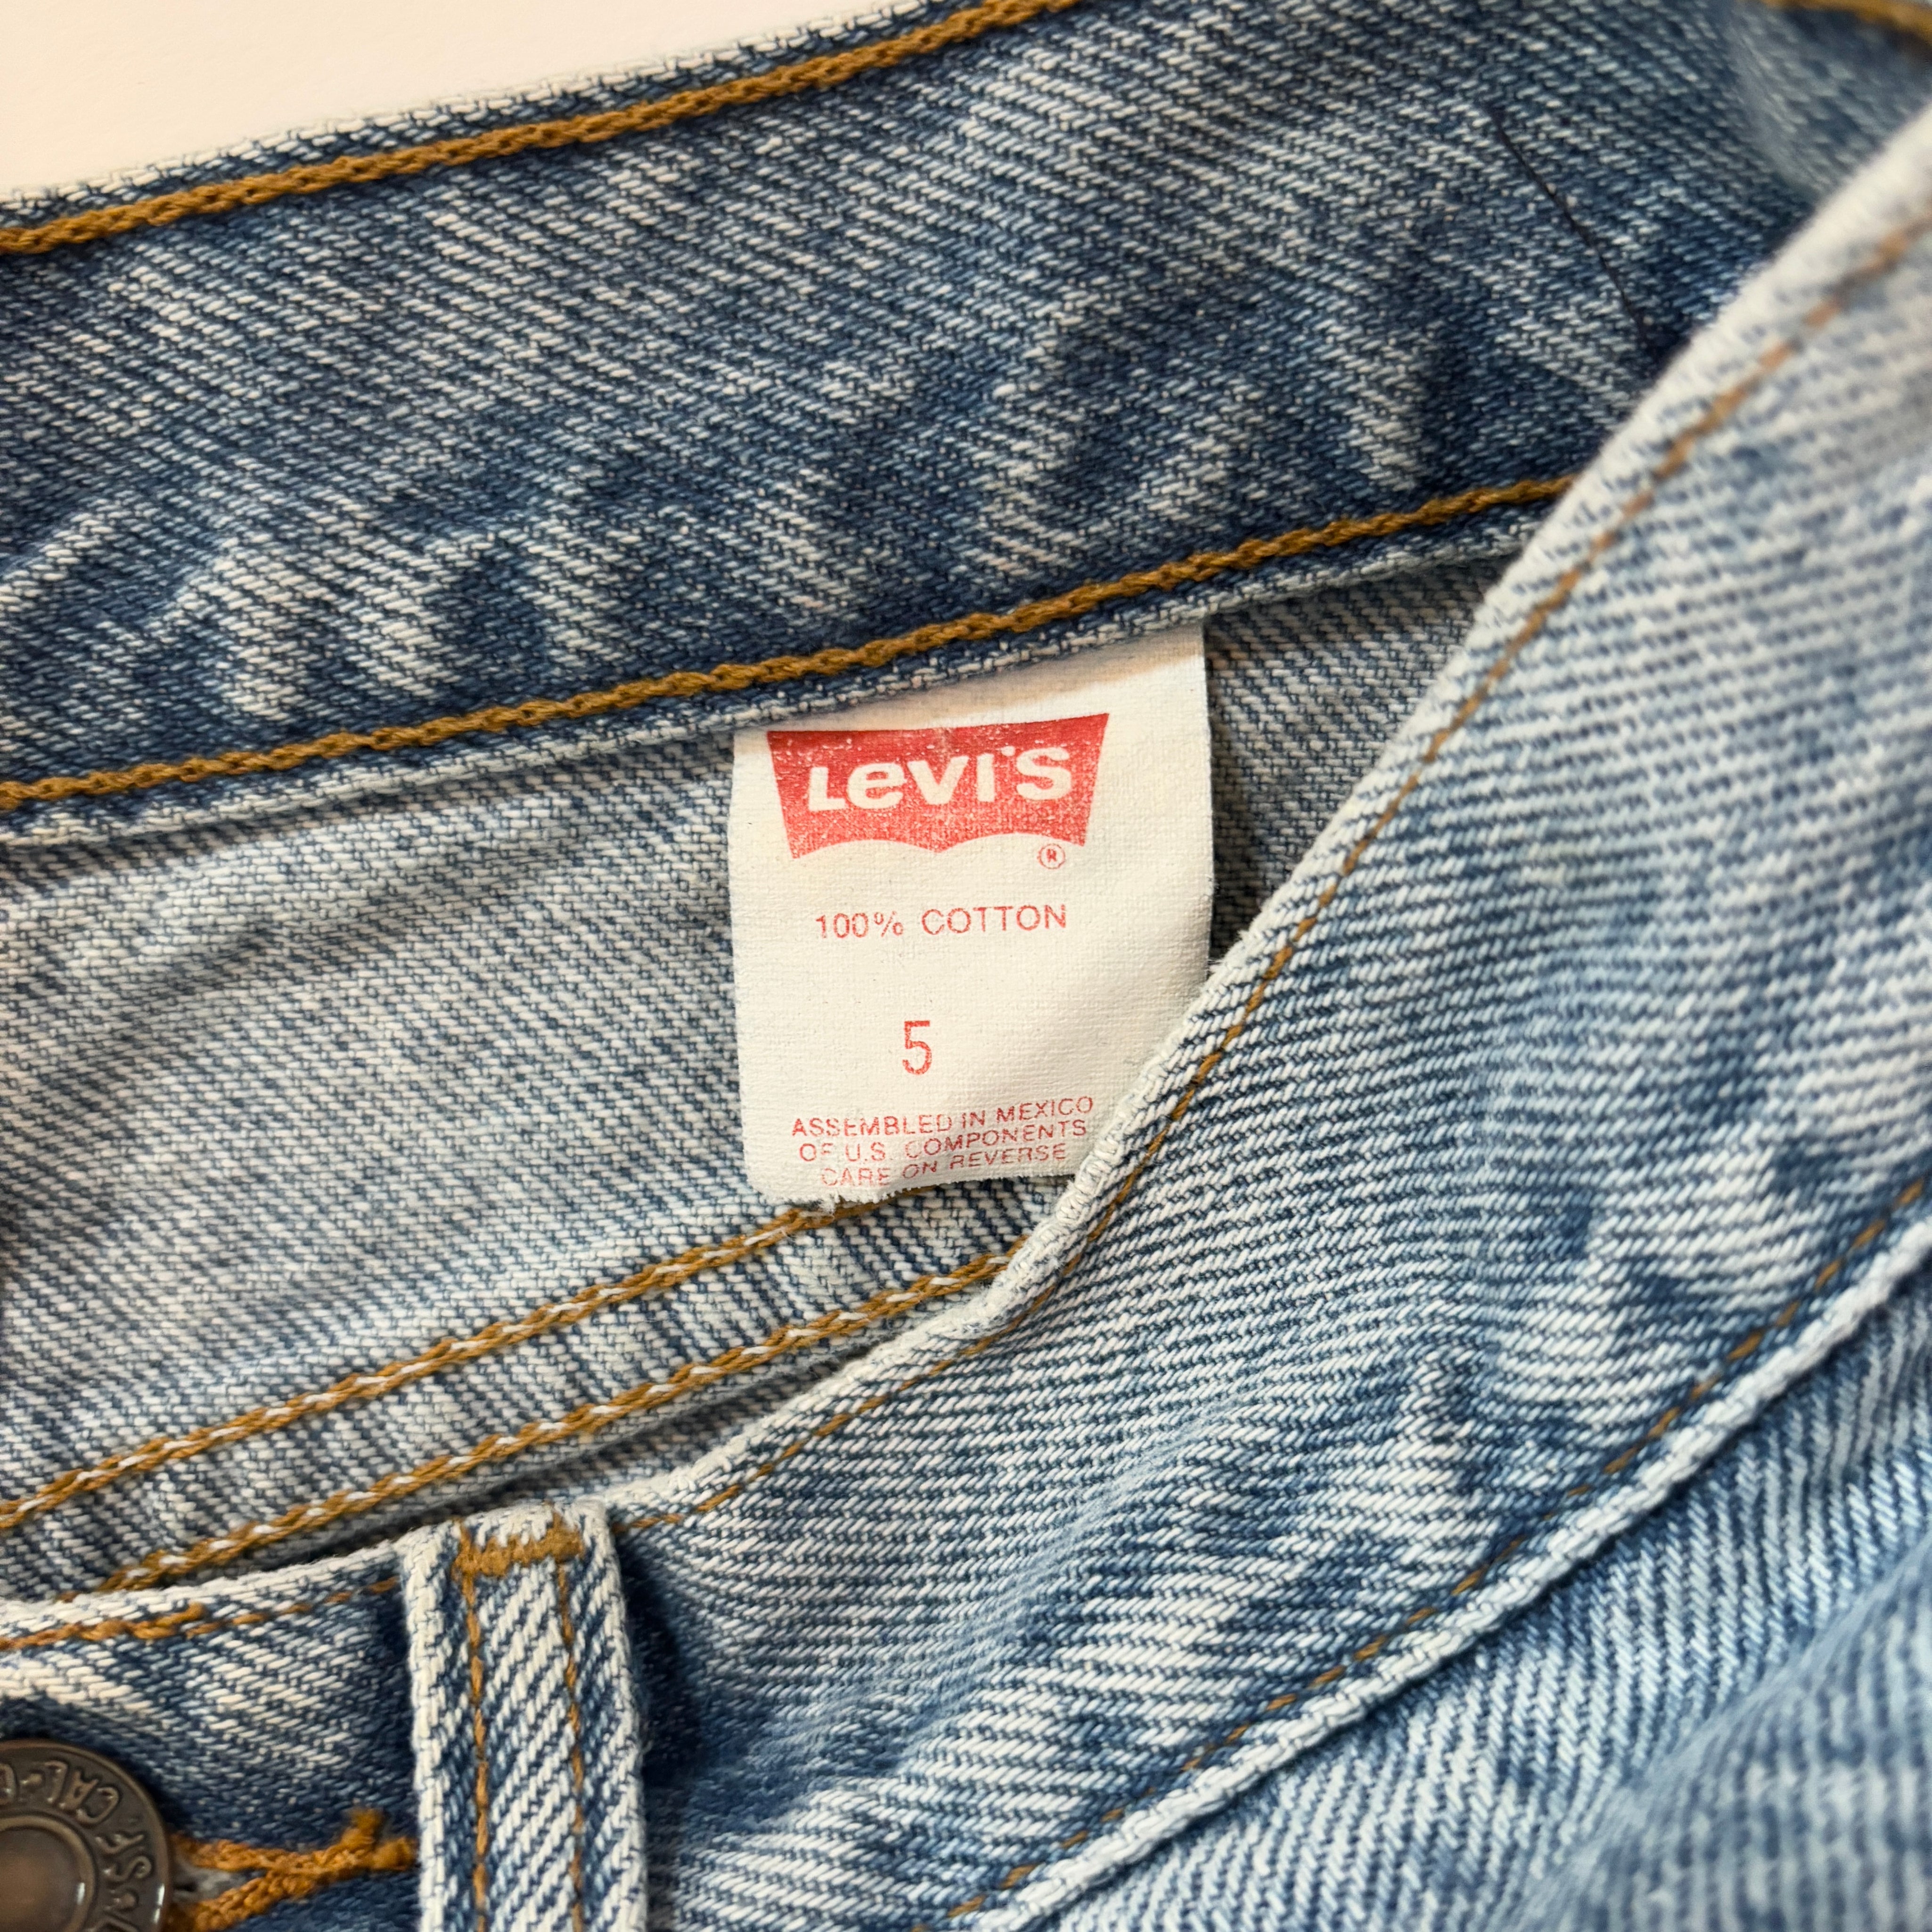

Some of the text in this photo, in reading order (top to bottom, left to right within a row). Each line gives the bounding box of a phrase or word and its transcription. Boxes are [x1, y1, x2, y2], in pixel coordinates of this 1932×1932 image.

[816, 904, 1066, 939] 100% COTTON
[902, 1020, 932, 1075] 5
[792, 1096, 1093, 1137] ASSEMBLED IN MEXICO
[799, 1142, 833, 1162] OF
[904, 1119, 1086, 1159] COMPONENTS
[821, 1142, 1066, 1186] CARE ON REVERSE
